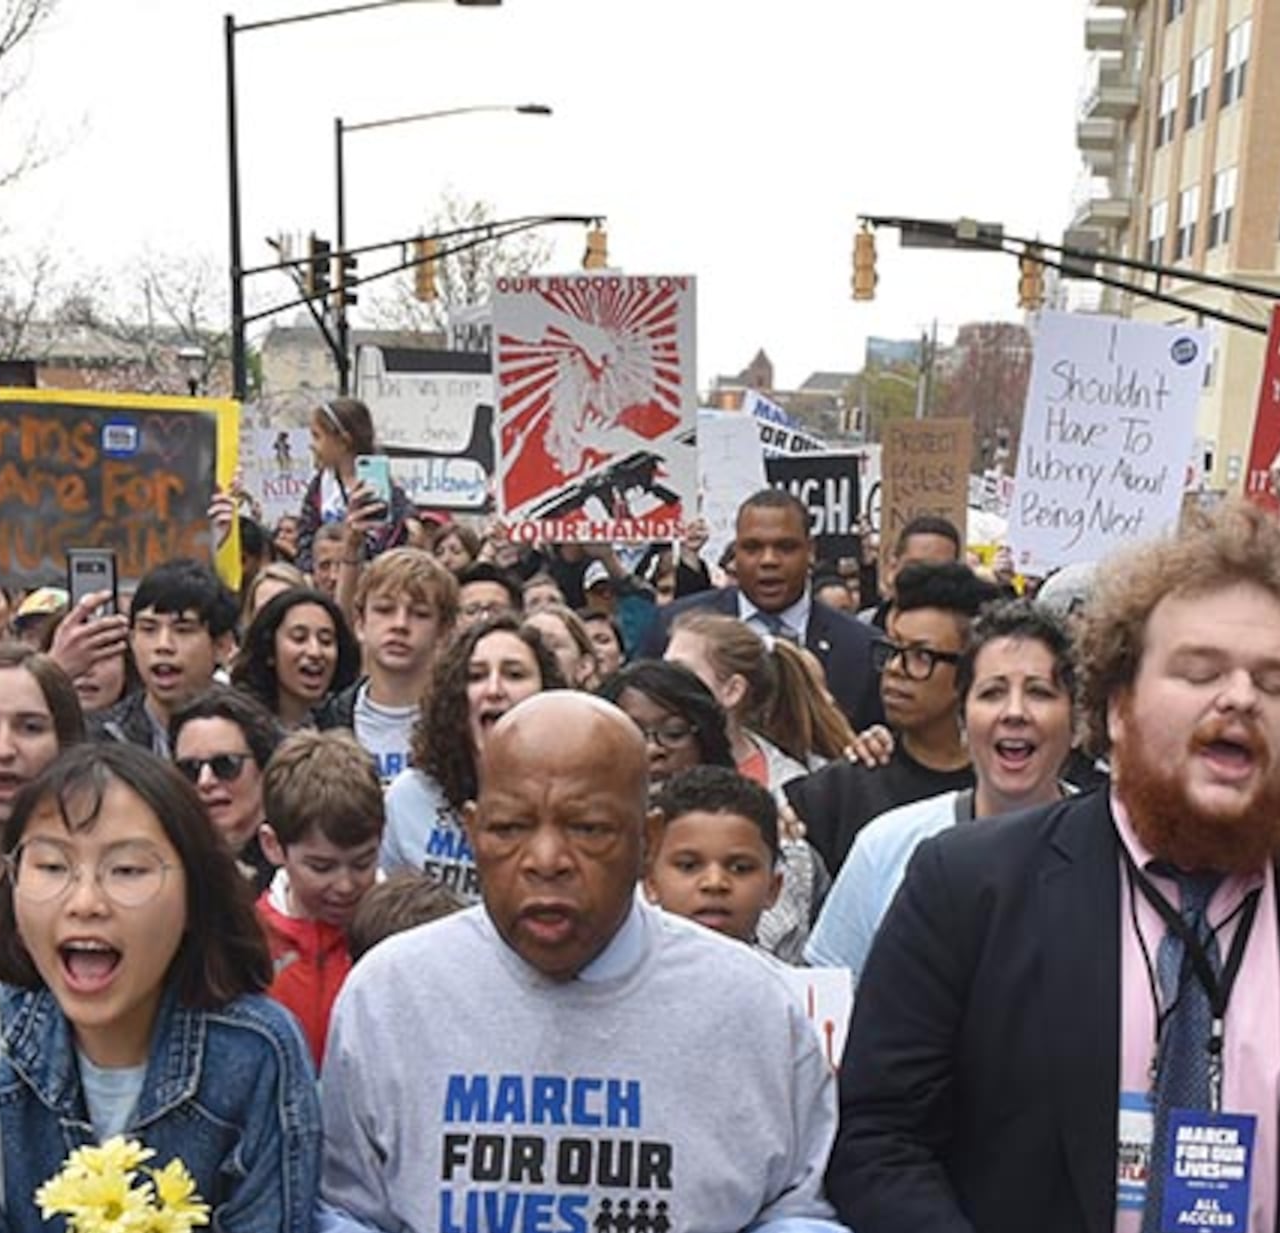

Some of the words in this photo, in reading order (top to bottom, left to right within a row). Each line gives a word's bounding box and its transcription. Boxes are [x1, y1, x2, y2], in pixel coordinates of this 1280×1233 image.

[496, 276, 540, 293] OUR
[548, 276, 625, 293] BLOOD
[630, 277, 650, 293] IS
[657, 275, 688, 292] ON
[1046, 359, 1171, 411] Shouldn't
[1120, 416, 1152, 456] To
[100, 461, 186, 522] For
[505, 520, 579, 544] YOUR
[589, 518, 689, 542] HANDS
[444, 1075, 642, 1129] MARCH
[1175, 1126, 1240, 1146] MARCH
[1175, 1144, 1209, 1161] FOR
[440, 1134, 545, 1185] FOR
[557, 1138, 674, 1191] OUR
[1177, 1210, 1236, 1227] ACCESS
